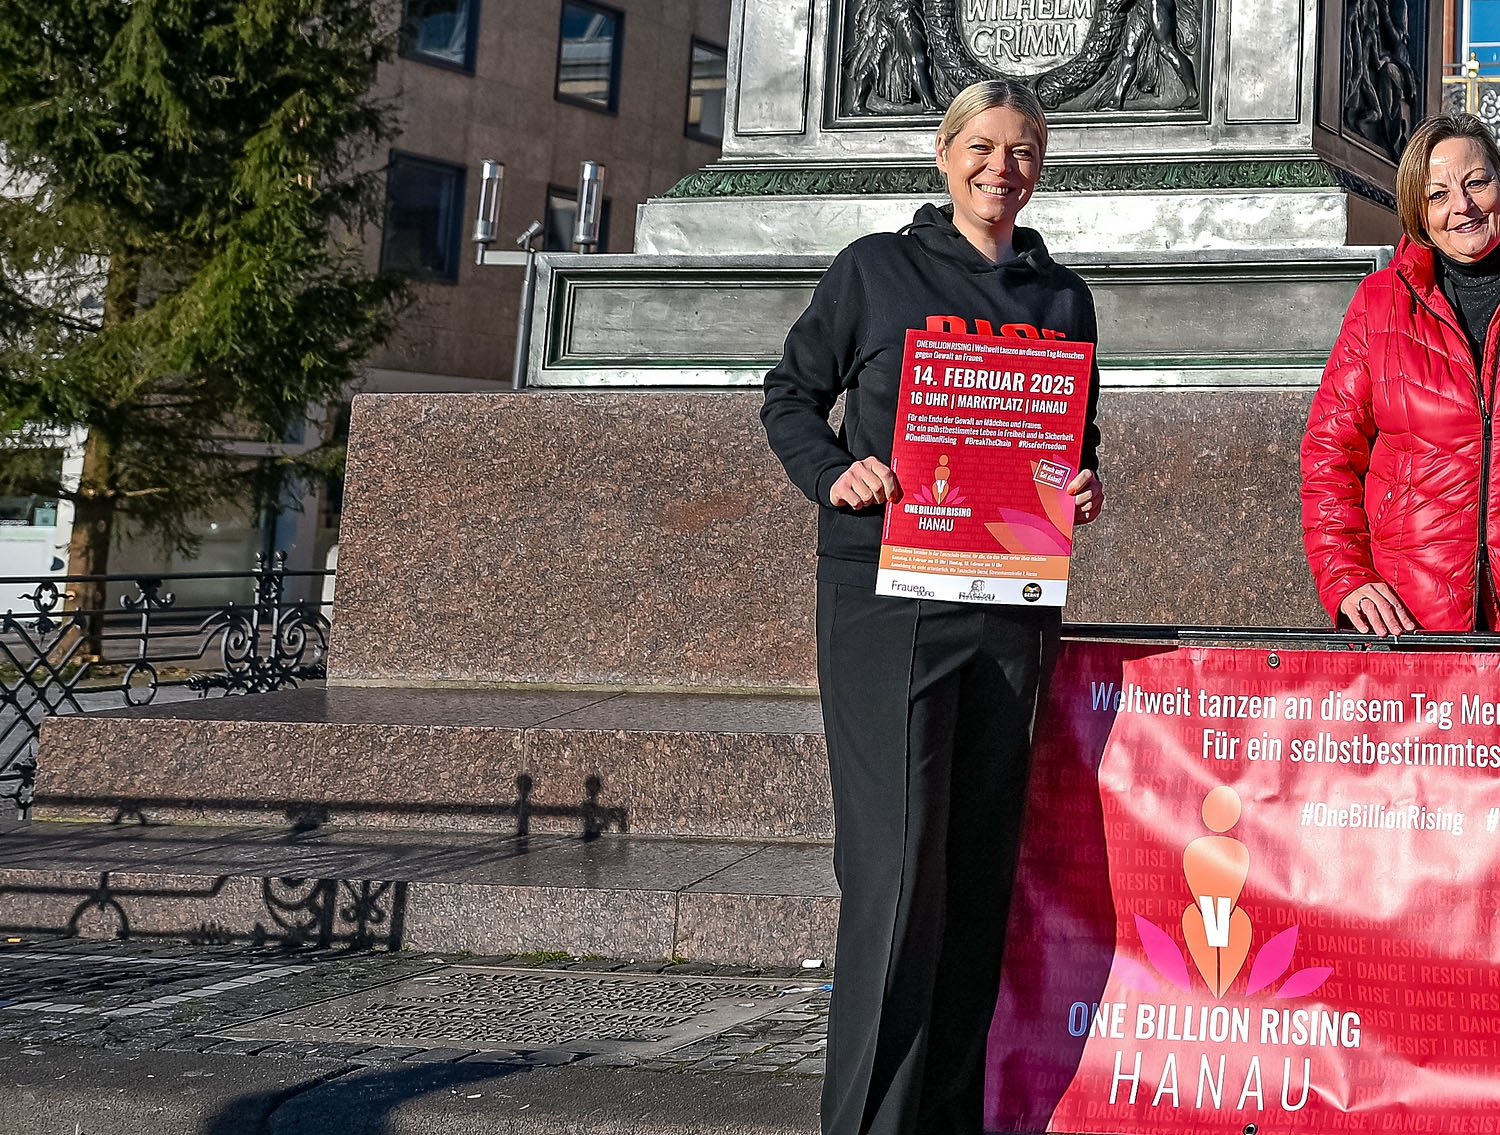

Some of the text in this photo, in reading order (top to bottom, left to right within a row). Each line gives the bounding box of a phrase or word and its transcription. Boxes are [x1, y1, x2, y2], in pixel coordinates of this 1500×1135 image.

[971, 21, 1077, 64] GRIMM
[916, 340, 929, 349] ONE
[929, 341, 951, 351] BILLION
[952, 343, 971, 352] RISING
[975, 344, 999, 354] Weltweit
[1026, 348, 1046, 356] diesem
[1047, 350, 1056, 358] Tag
[934, 352, 954, 360] Gewalt
[913, 365, 1074, 395] 14. FEBRUAR 2025
[910, 392, 922, 404] 16
[926, 392, 948, 406] UHR
[957, 395, 1023, 411] MARKTPLATZ
[1032, 400, 1067, 414] HANAU
[908, 414, 917, 422] Für
[918, 415, 927, 423] ein
[955, 417, 974, 425] Gewalt
[984, 419, 1009, 427] Mädchen
[907, 424, 916, 432] Für
[928, 426, 979, 436] selbstbestimmtes
[980, 428, 996, 436] Leben
[1004, 430, 1025, 438] Freiheit
[965, 437, 1011, 447] #BreakTheChain
[904, 504, 971, 517] ONE BILLION RISING
[919, 517, 954, 531] HANAU
[1091, 681, 1191, 717] Weltweit
[1199, 689, 1276, 720] tanzen
[1284, 696, 1313, 721] an
[1320, 691, 1404, 723] diesem
[1411, 693, 1454, 730] Tag
[1202, 728, 1240, 760] Für
[1247, 732, 1281, 762] ein
[1301, 802, 1465, 836] #OneBillionRising
[1317, 934, 1366, 955] DANCE
[1421, 966, 1473, 986] RESIST
[1405, 989, 1455, 1009] DANCE
[1068, 1001, 1361, 1048] ONE BILLION RISING
[1108, 1050, 1311, 1112] HANAU
